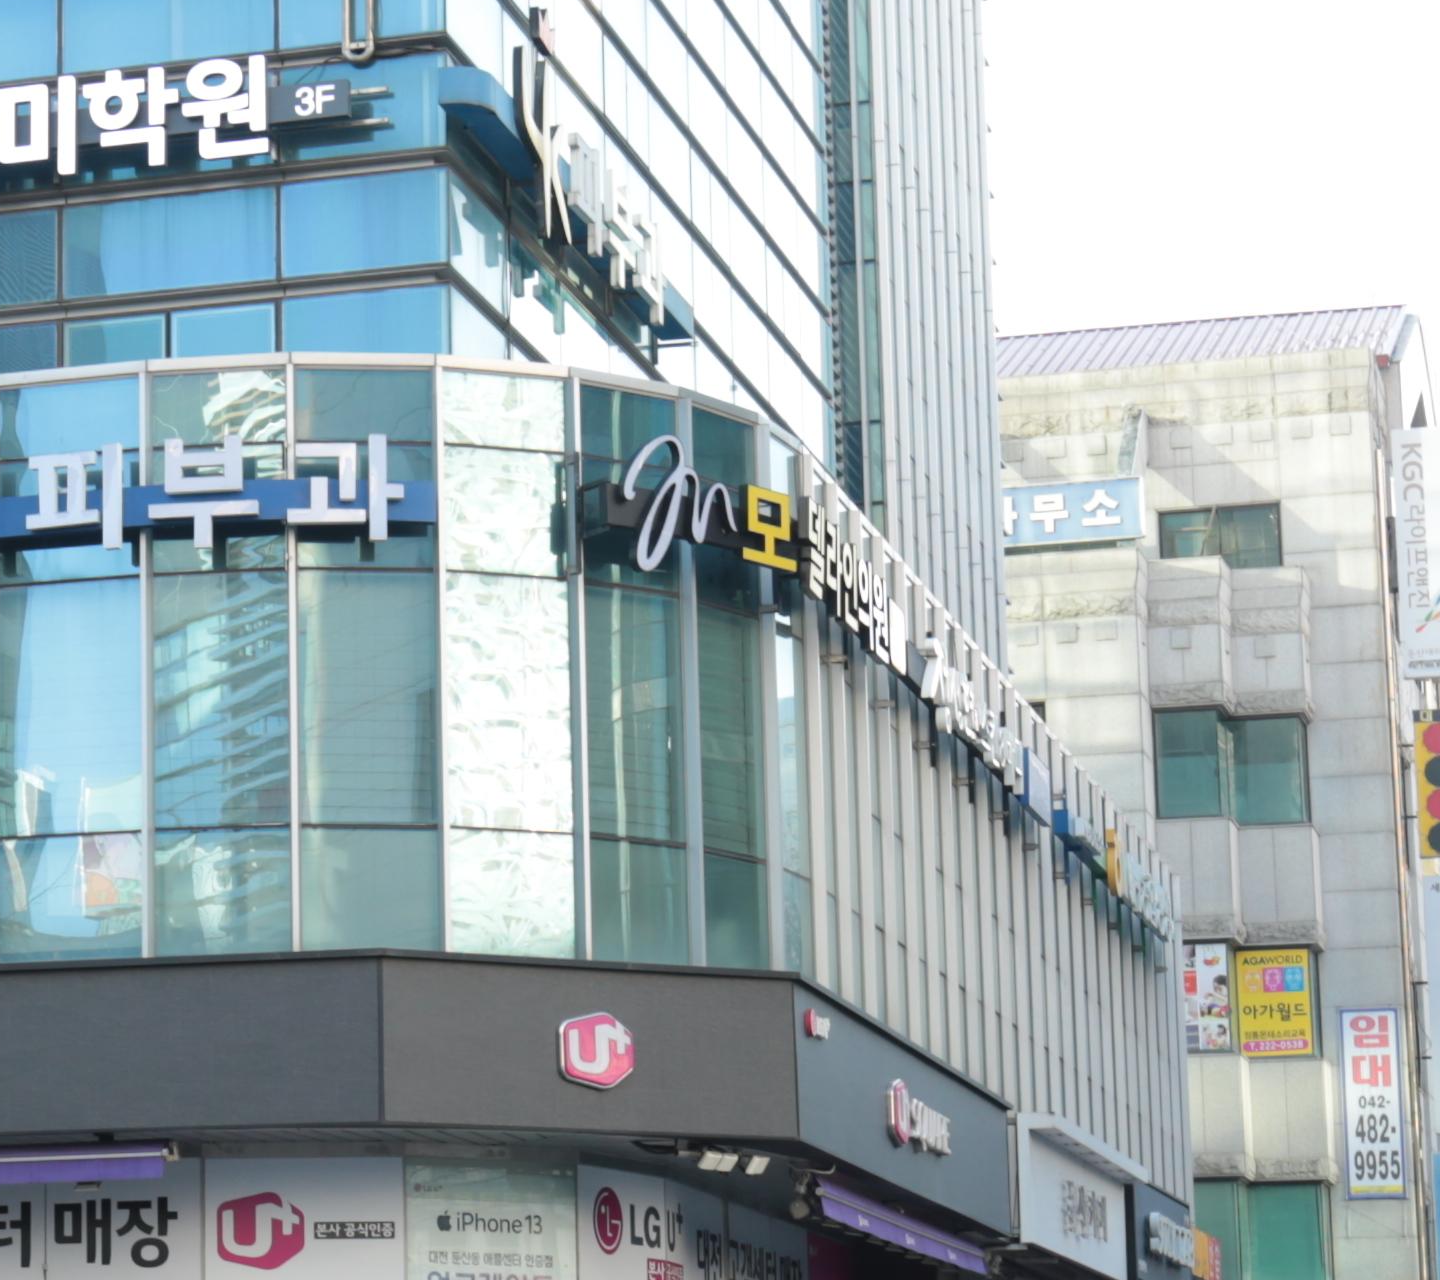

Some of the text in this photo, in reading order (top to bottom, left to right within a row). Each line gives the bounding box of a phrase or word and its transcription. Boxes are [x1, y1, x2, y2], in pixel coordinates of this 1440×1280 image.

[294, 84, 336, 117] 3F
[1242, 955, 1303, 966] AGAWORLD
[1242, 1002, 1307, 1021] 아가월드
[1349, 1014, 1392, 1088] 임대
[1354, 1150, 1401, 1182] 9955
[54, 1196, 178, 1268] 매장
[315, 1222, 393, 1238] 본사 공식인증
[457, 1211, 543, 1234] iPhone 13
[629, 1203, 661, 1250] LG
